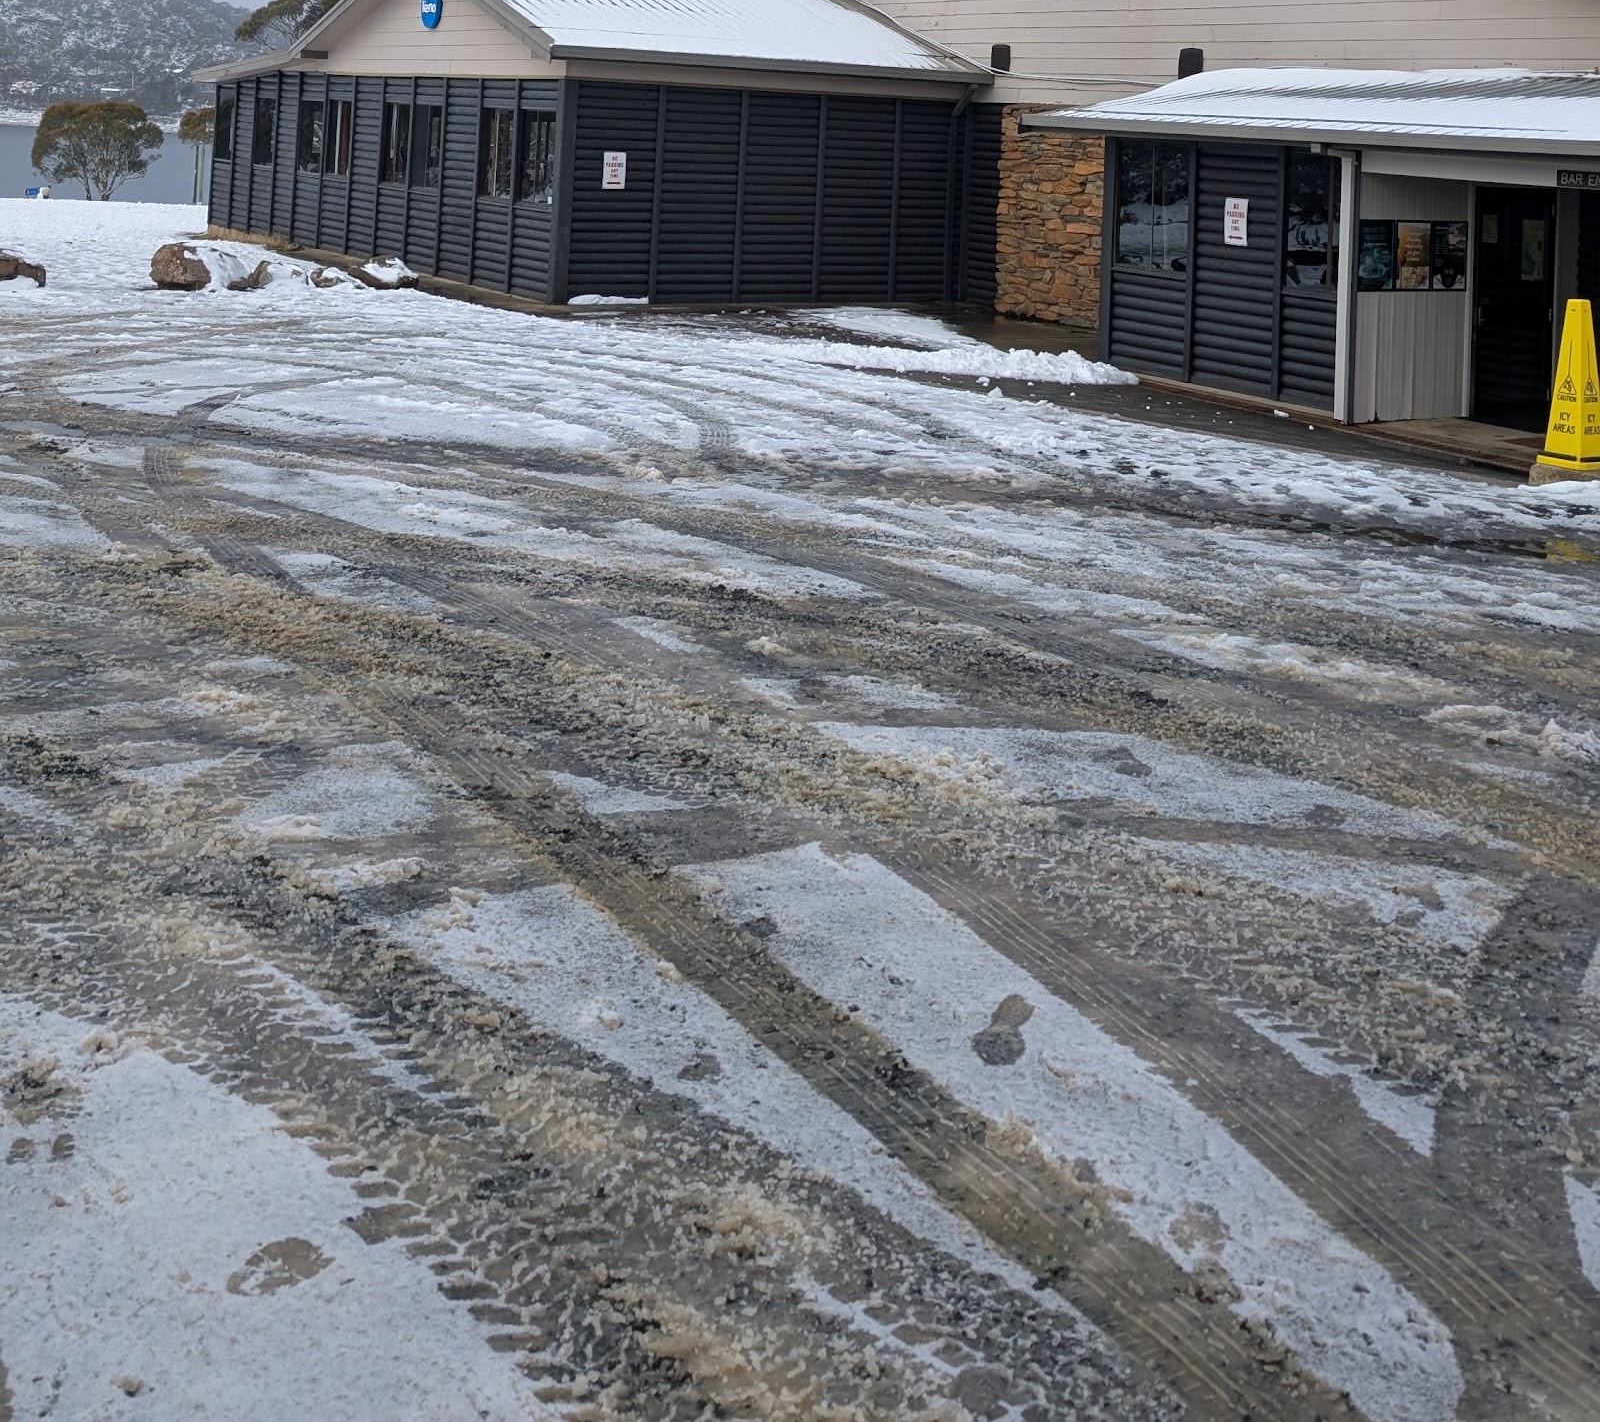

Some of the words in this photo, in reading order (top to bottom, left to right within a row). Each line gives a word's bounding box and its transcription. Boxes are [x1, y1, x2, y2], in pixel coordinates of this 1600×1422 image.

[1561, 173, 1583, 185] BAR
[1557, 395, 1577, 403] CAUTION
[1559, 412, 1571, 421] ICY
[1587, 414, 1596, 423] ICY
[1553, 423, 1576, 435] AREAS
